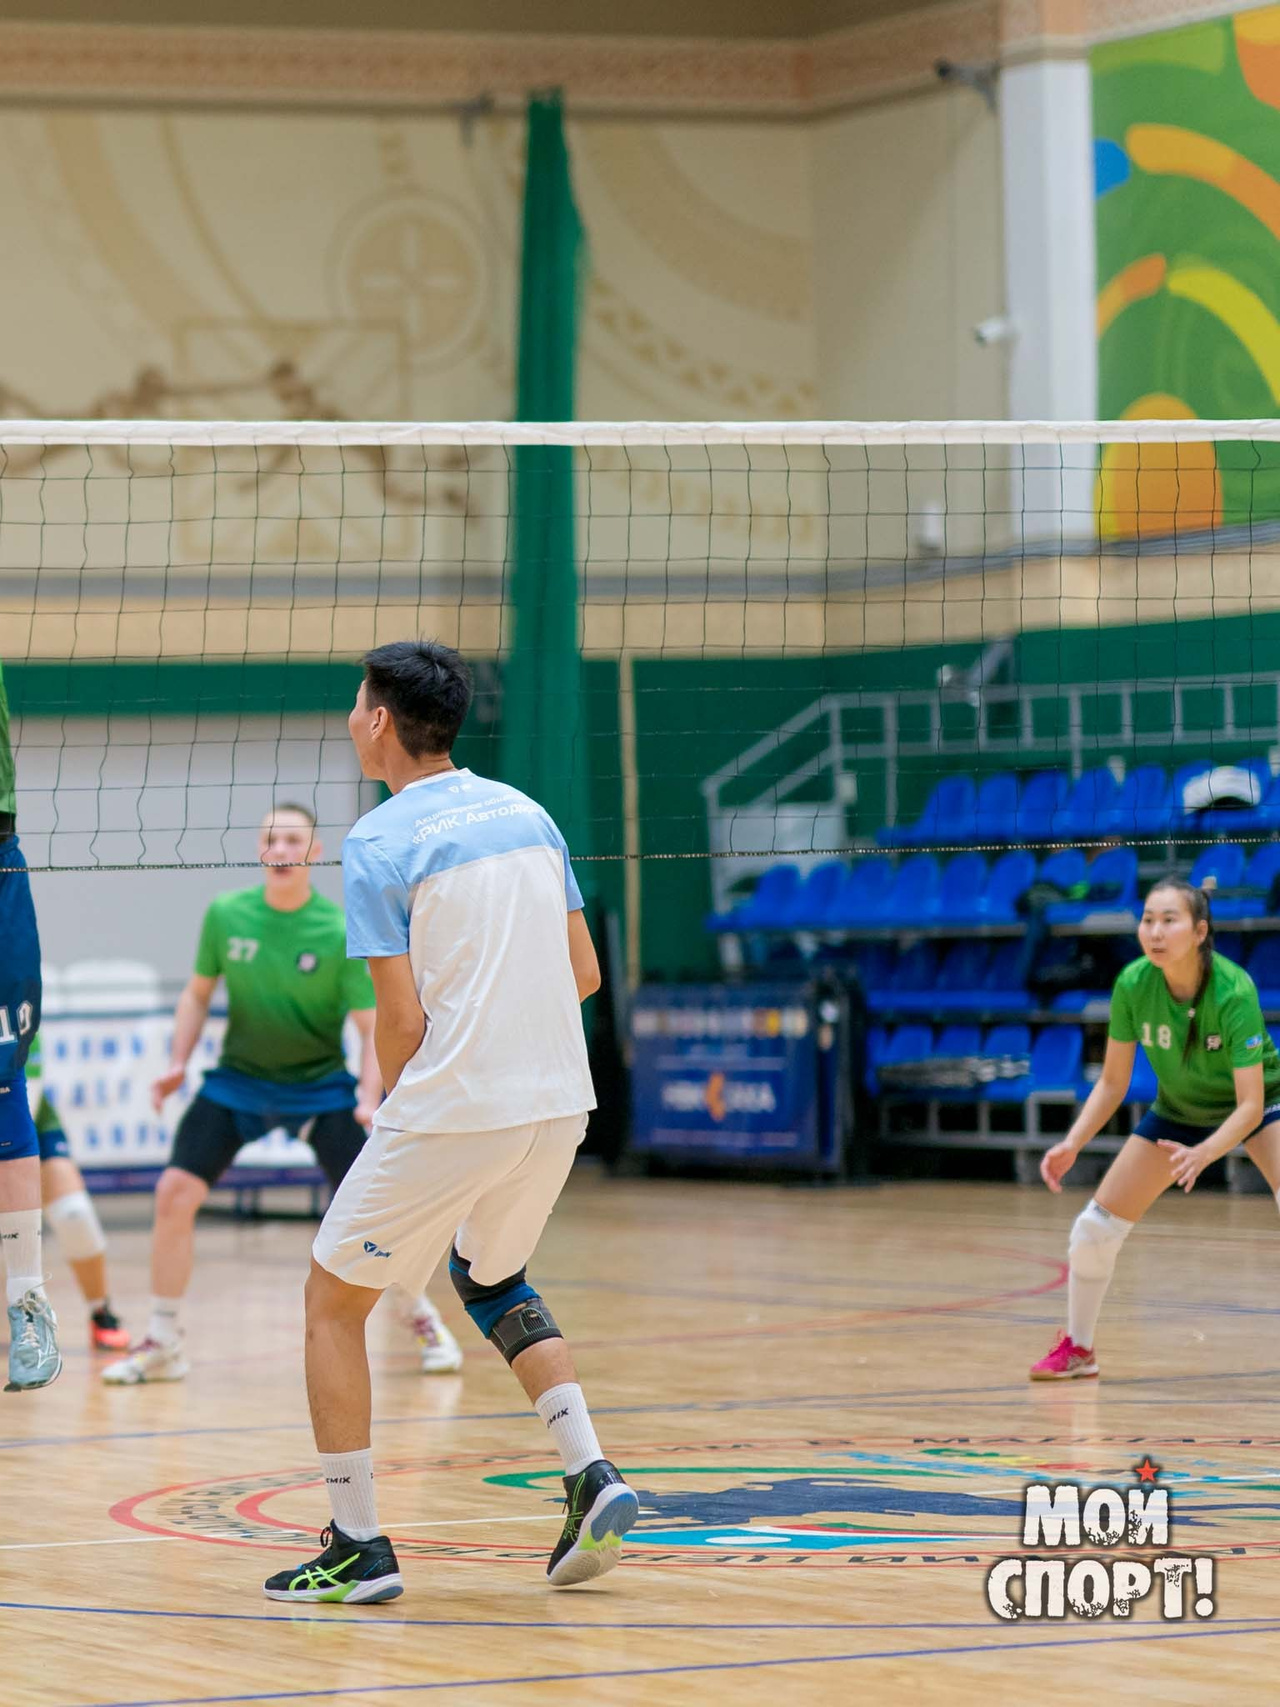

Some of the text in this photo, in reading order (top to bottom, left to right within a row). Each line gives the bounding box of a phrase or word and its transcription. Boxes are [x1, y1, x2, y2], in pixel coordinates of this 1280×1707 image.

[411, 815, 462, 845] «РИК
[227, 937, 259, 962] 27
[1141, 1022, 1172, 1050] 18
